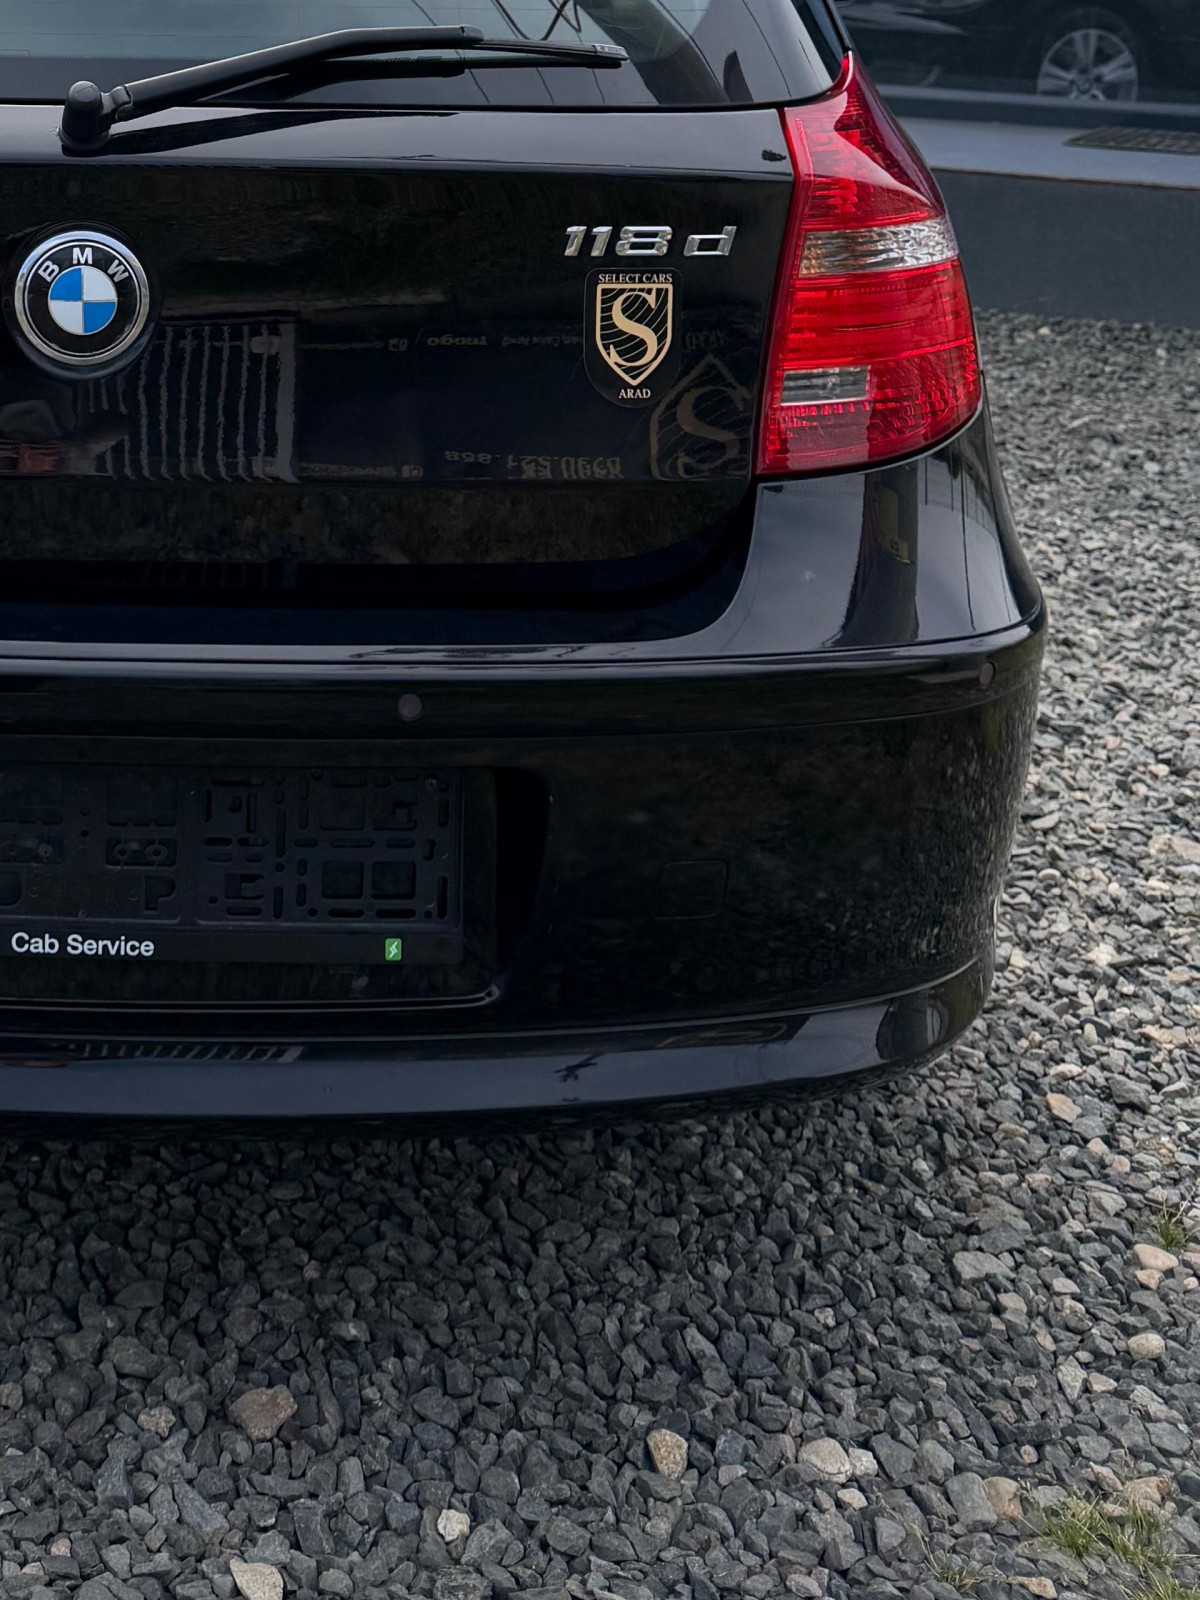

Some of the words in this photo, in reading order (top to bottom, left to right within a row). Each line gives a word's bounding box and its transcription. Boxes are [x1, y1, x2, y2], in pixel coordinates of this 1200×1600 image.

[563, 225, 674, 257] 118
[683, 225, 738, 257] d
[37, 246, 130, 284] BMW
[597, 273, 641, 284] SELECT
[642, 273, 673, 284] CARS
[611, 287, 658, 367] S
[618, 388, 652, 399] ARAD
[10, 931, 60, 955] Cab
[66, 933, 155, 957] Service
